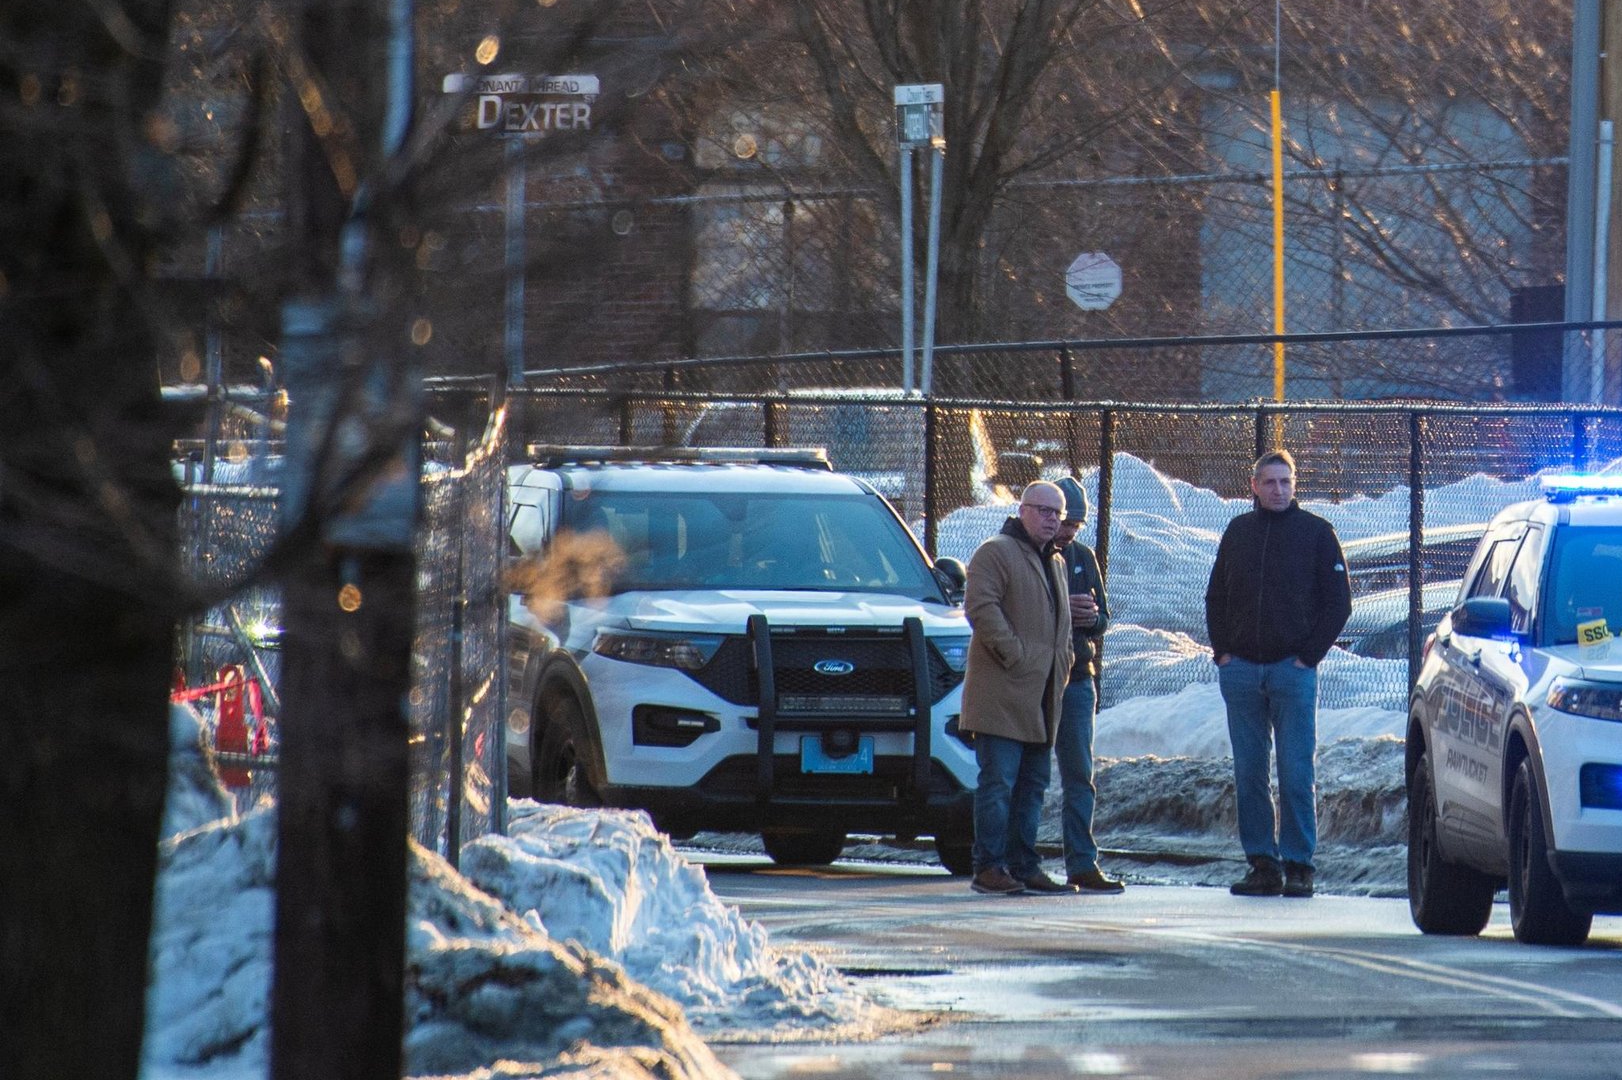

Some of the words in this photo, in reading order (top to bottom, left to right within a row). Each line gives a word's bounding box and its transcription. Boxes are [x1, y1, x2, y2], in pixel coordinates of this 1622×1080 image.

[477, 95, 592, 130] DEXTER
[1433, 671, 1505, 751] POLICE
[1446, 749, 1490, 785] PAWTUCKET
